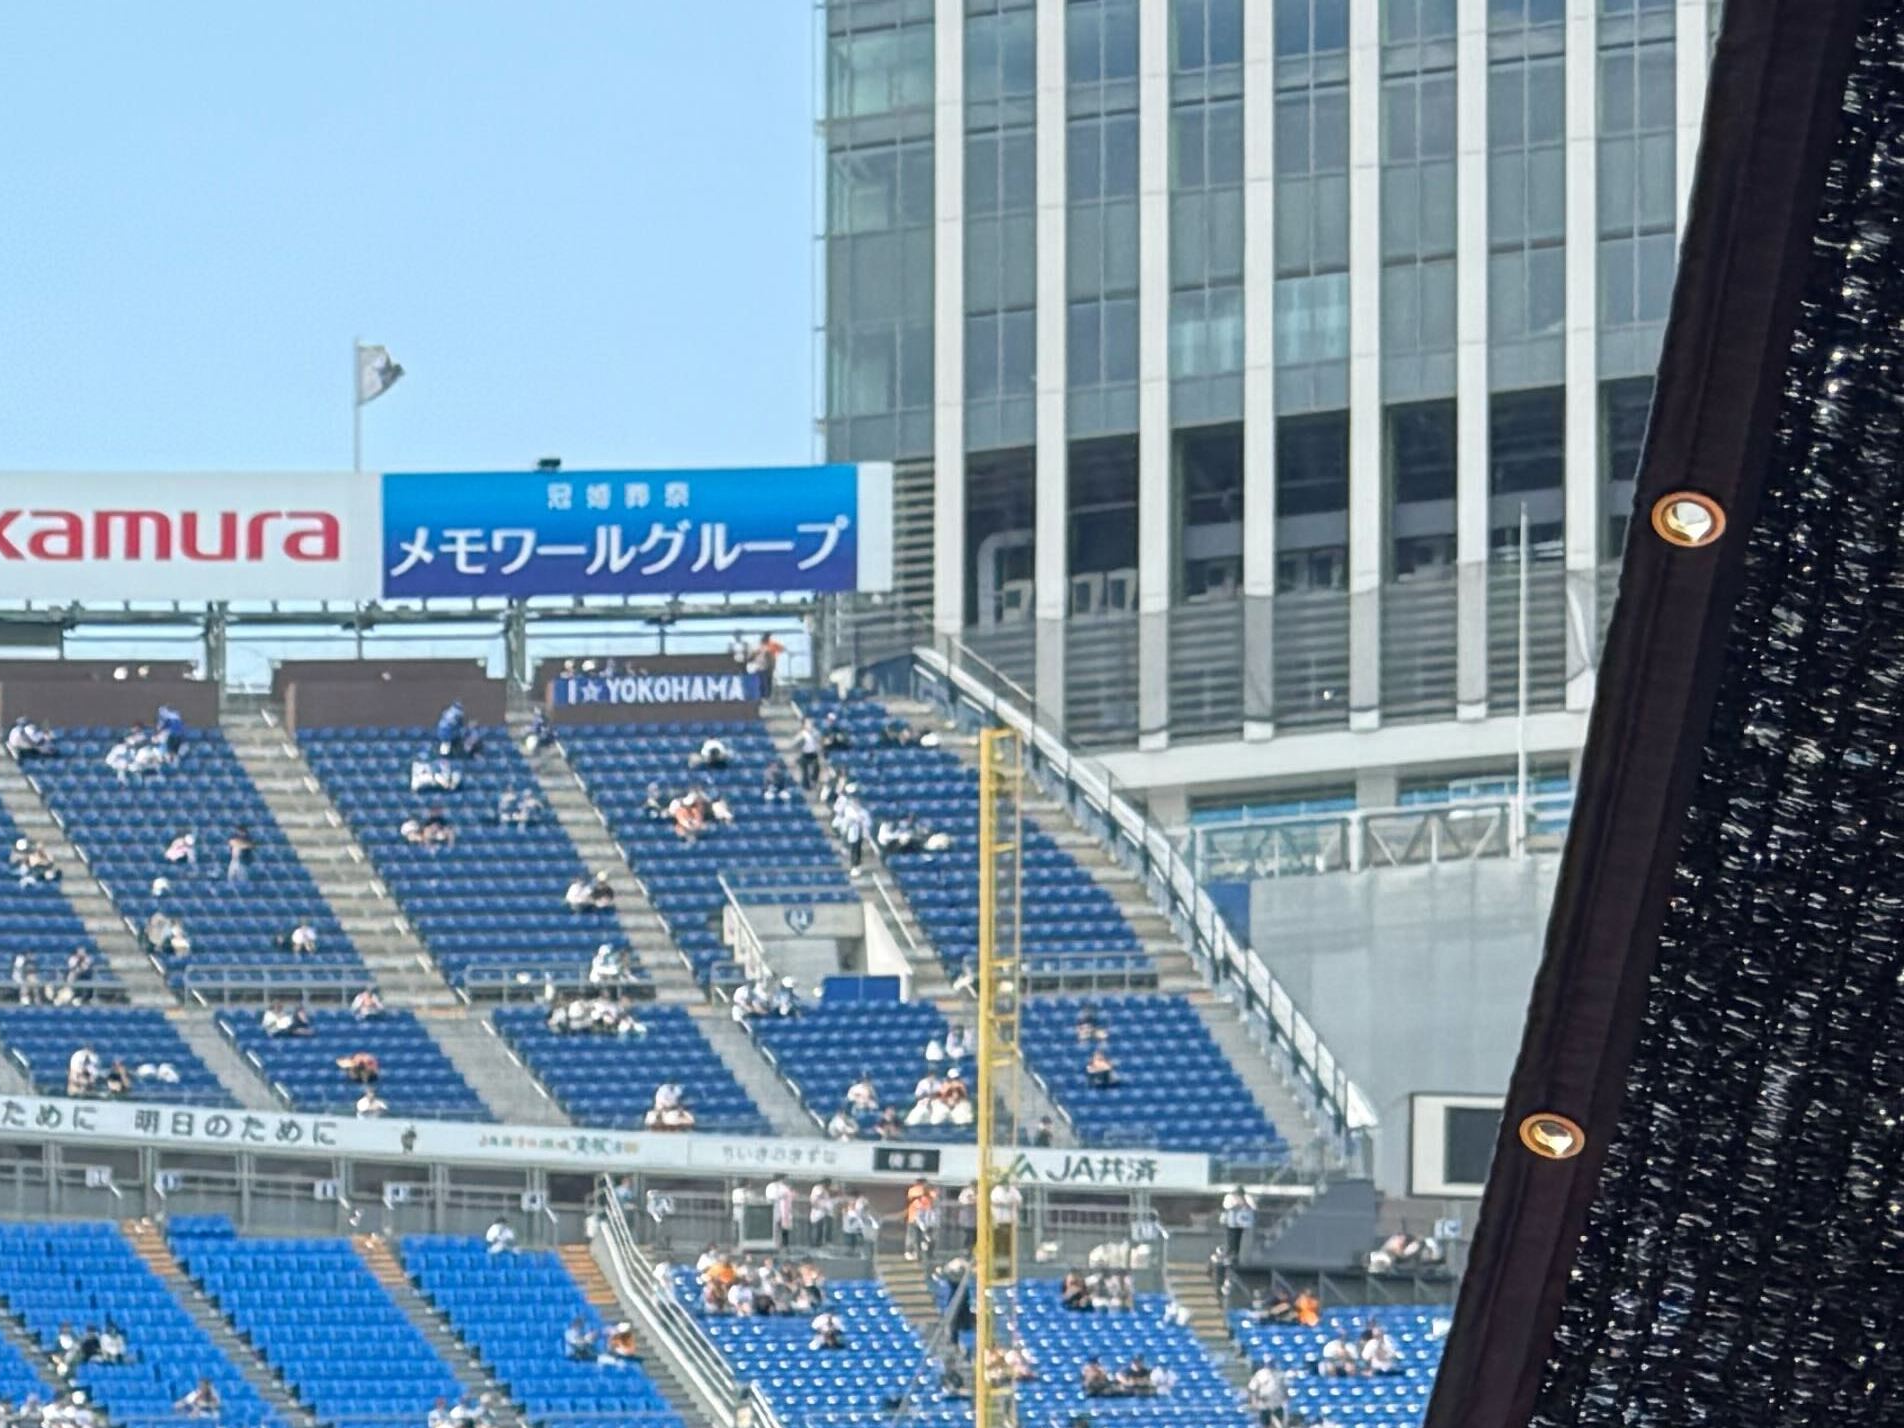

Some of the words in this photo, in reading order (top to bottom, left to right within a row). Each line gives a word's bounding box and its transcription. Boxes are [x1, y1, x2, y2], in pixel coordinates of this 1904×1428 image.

[390, 515, 849, 577] メモワールグループ
[606, 673, 745, 703] YOKOHAMA
[134, 1107, 339, 1148] 明日のために
